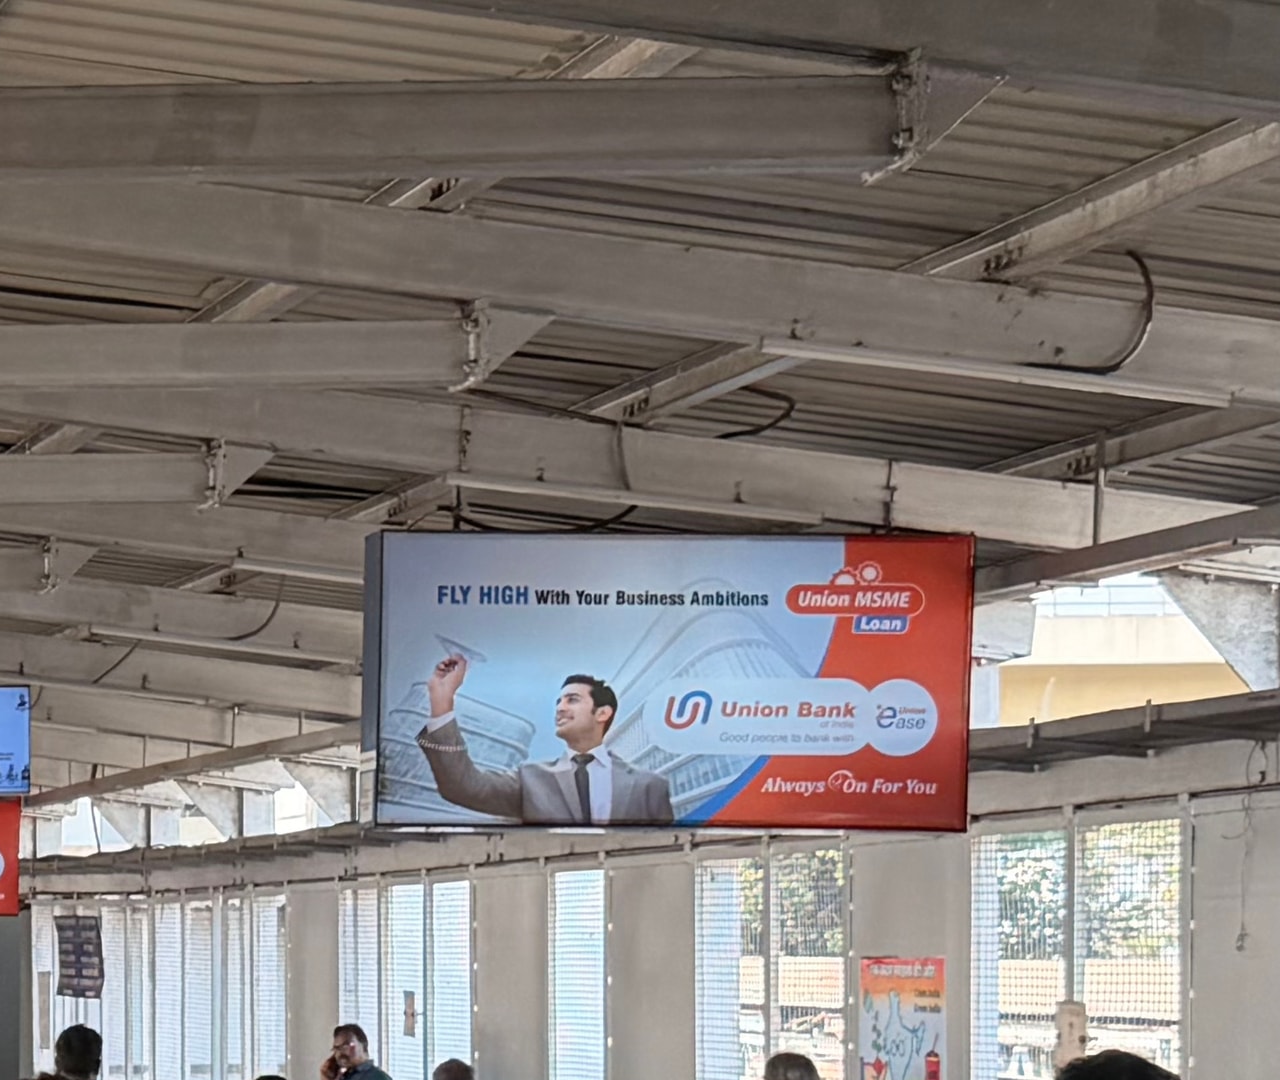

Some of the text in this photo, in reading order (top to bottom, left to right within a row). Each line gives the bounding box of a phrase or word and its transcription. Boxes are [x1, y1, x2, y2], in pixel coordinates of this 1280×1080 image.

[437, 585, 769, 607] FLY HIGH With Your Business Ambitions
[798, 591, 910, 608] Union MSME
[861, 617, 902, 631] Loan
[721, 701, 856, 718] Union Bank
[720, 732, 749, 743] Good
[761, 777, 937, 795] Always On For You
